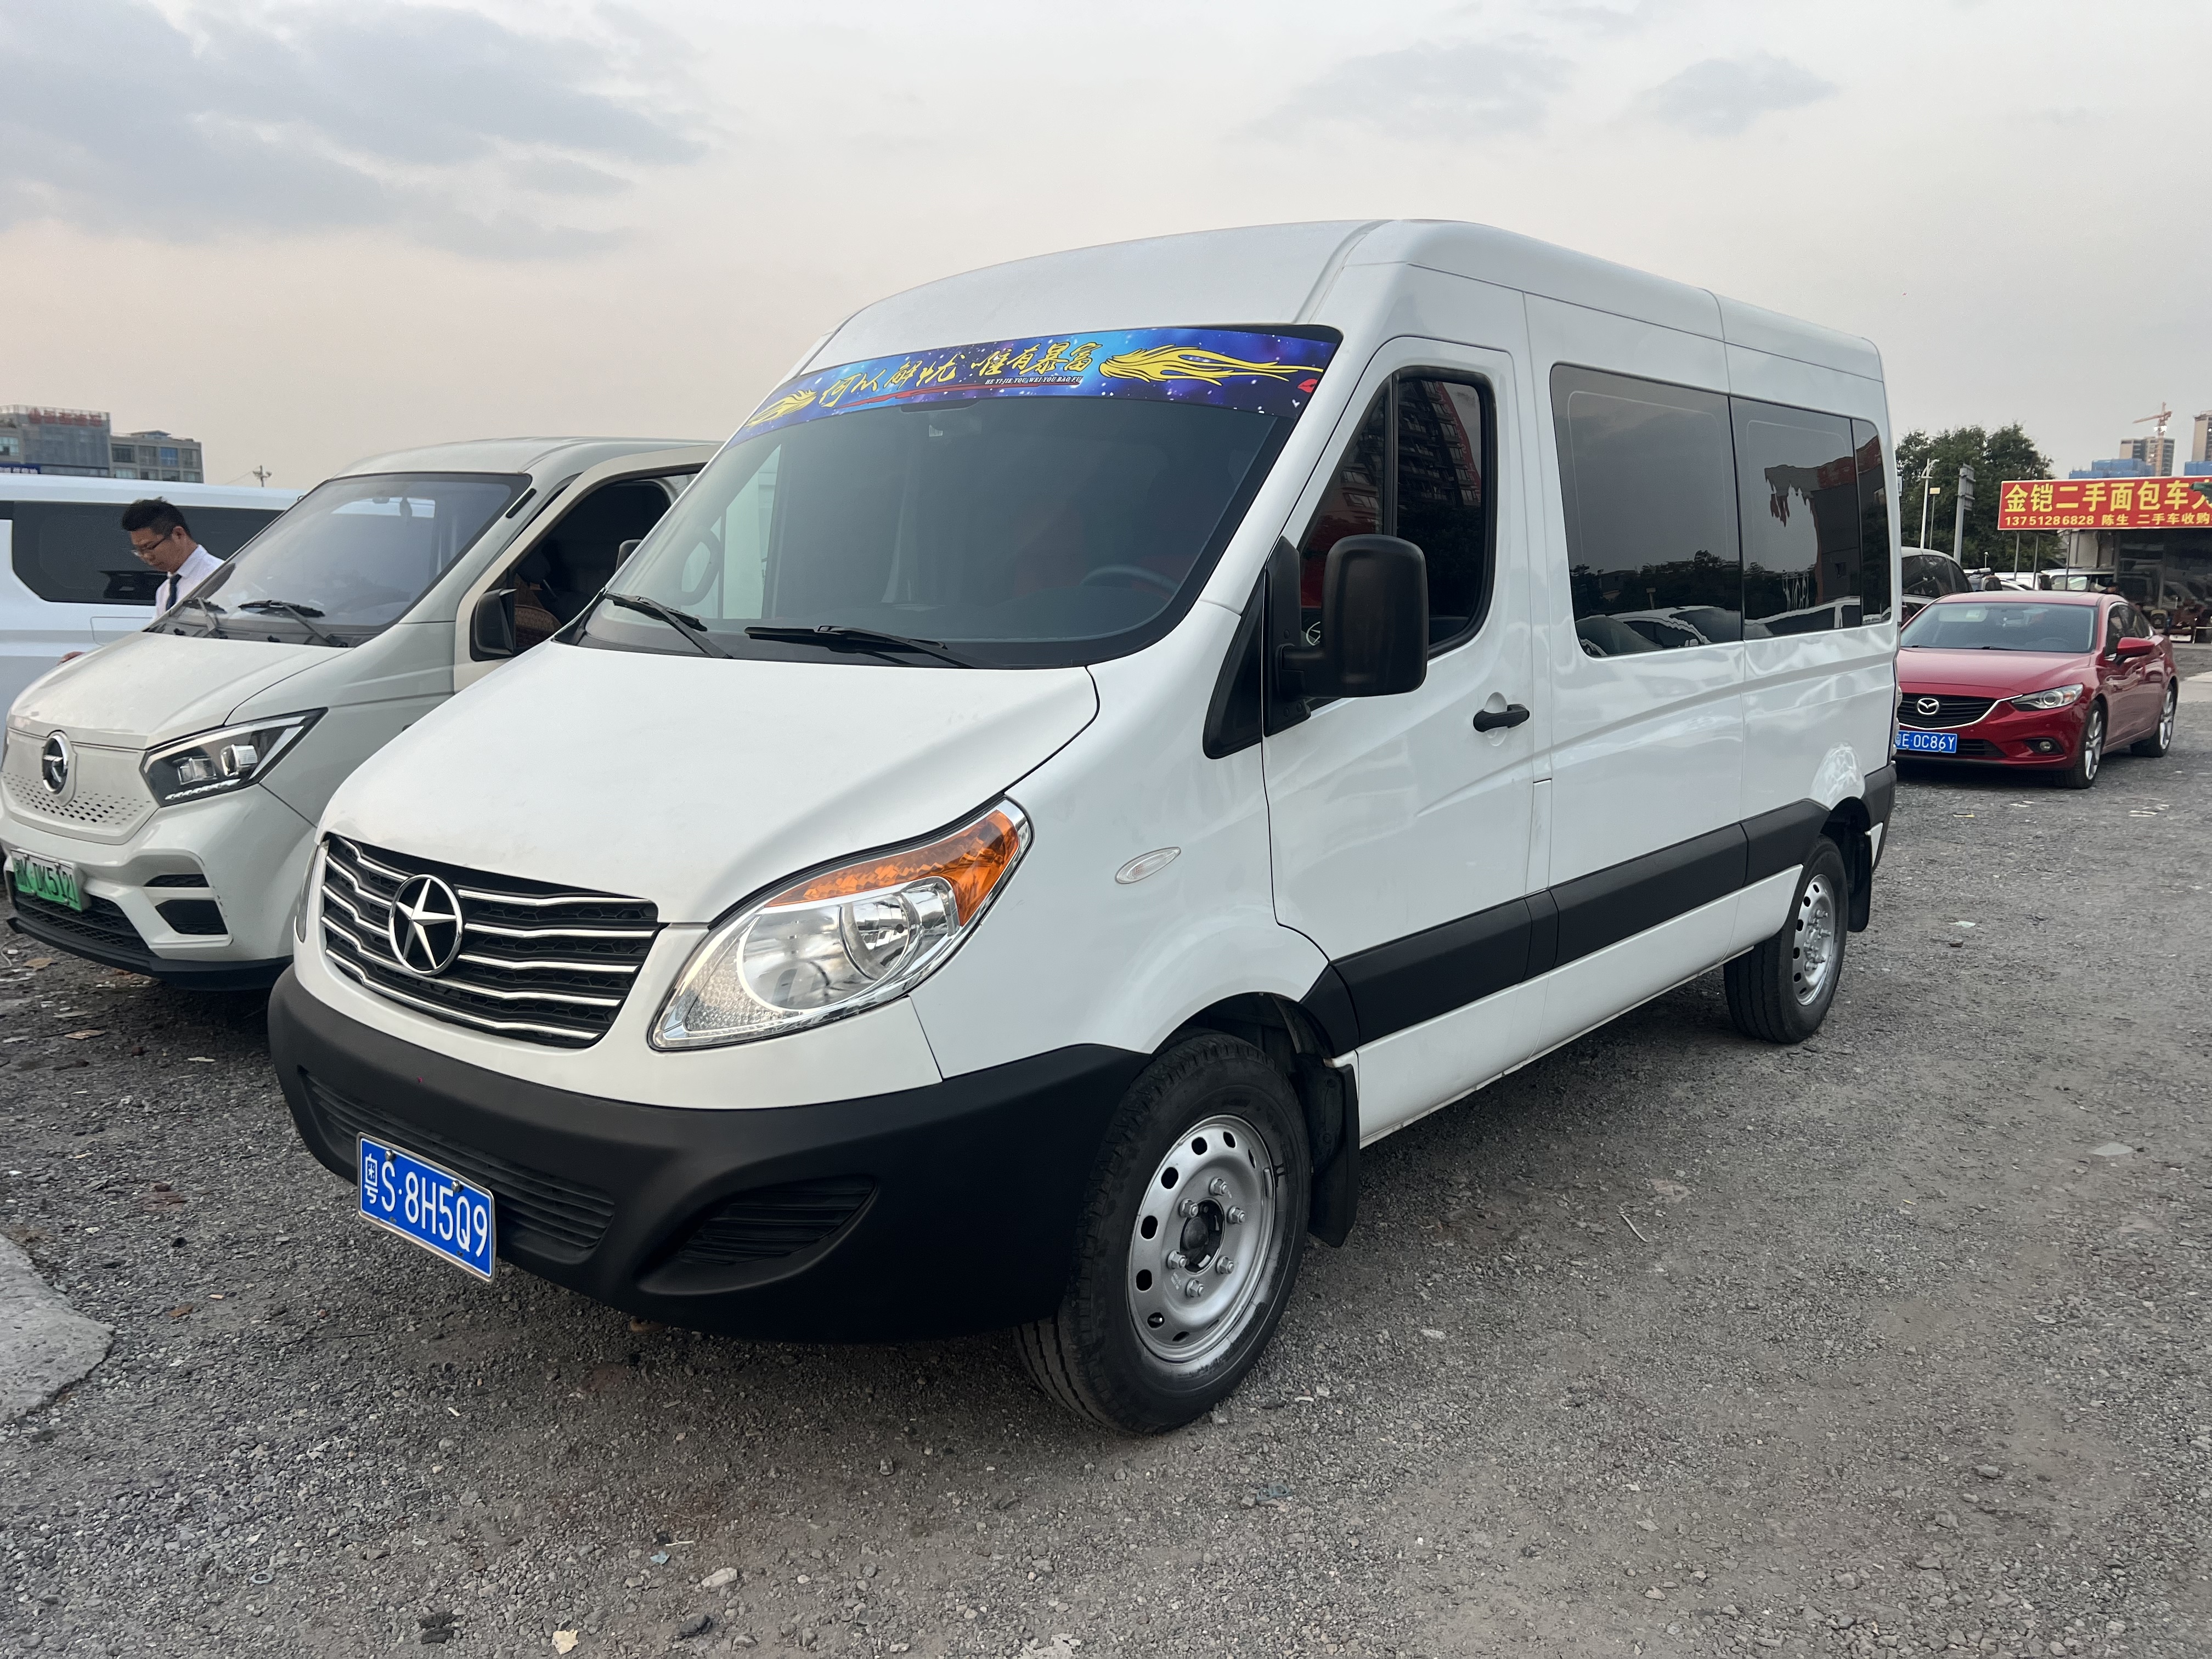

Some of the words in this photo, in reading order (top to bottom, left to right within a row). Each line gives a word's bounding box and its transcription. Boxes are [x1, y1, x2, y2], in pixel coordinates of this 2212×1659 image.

[970, 341, 1103, 376] 唯有暴富
[2005, 515, 2095, 526] 13751286828
[2101, 514, 2129, 526] 陈生
[2137, 512, 2212, 525] 二手车收购
[364, 1153, 488, 1257] 粤S·8H5Q9
